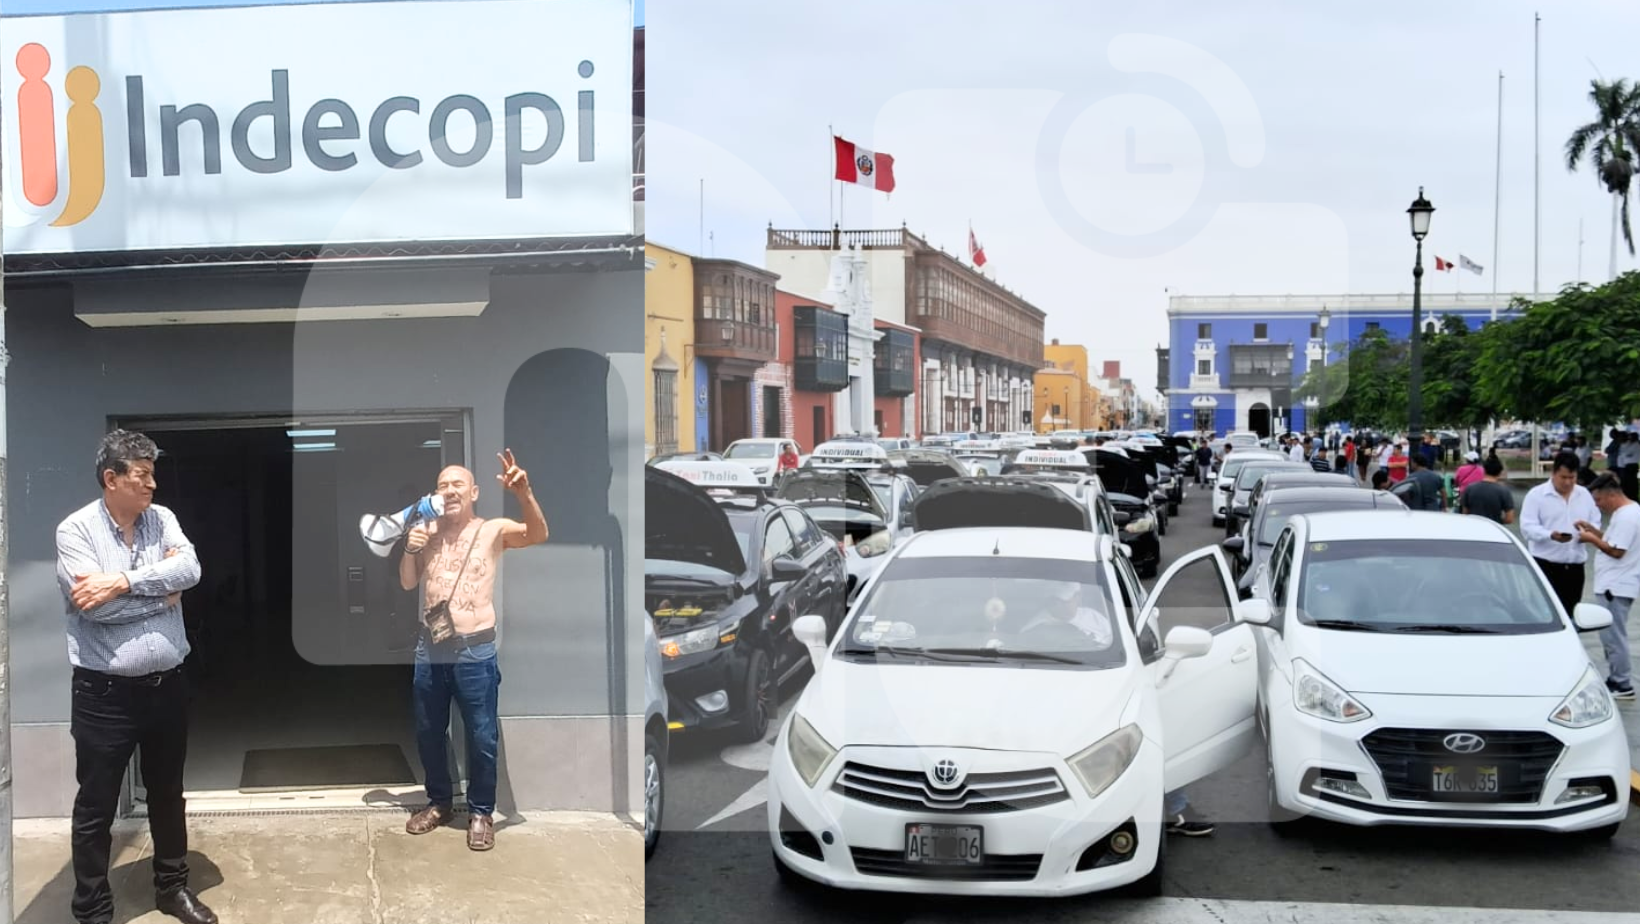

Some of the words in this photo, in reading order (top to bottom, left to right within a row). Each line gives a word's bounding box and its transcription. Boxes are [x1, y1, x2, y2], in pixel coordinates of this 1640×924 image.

[125, 60, 596, 199] Indecopi
[1025, 455, 1067, 463] INDIVIDUAL
[702, 470, 738, 481] Thalia
